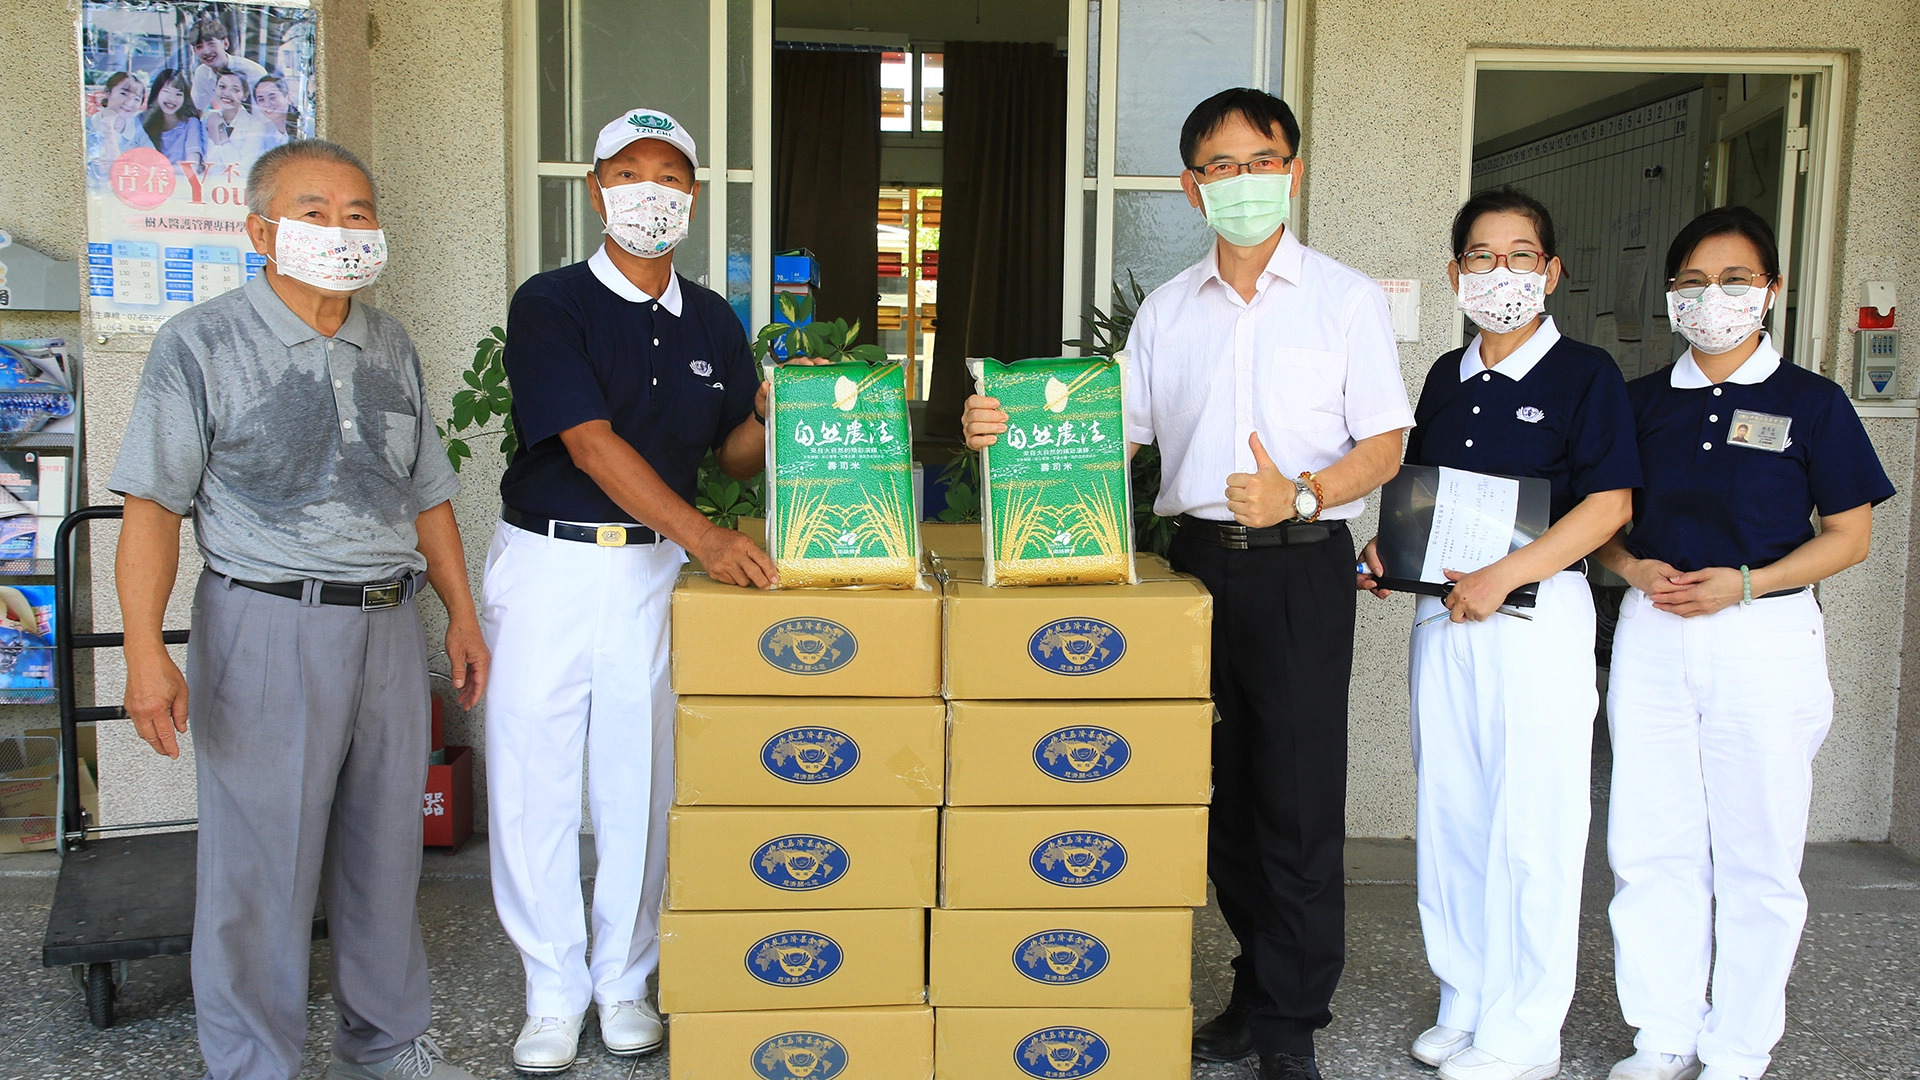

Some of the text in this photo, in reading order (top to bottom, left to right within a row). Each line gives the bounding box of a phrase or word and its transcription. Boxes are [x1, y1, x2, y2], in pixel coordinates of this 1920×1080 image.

[1556, 138, 1564, 150] 13
[1564, 135, 1572, 147] 12
[1573, 133, 1579, 144] 11
[1581, 129, 1588, 141] 10
[1590, 126, 1596, 138] 9
[1599, 124, 1605, 137] 8
[1608, 121, 1614, 134] 7
[1617, 118, 1623, 131] 6
[1627, 115, 1633, 129] 5
[1636, 112, 1642, 125] 4
[1647, 108, 1653, 122] 3
[1656, 105, 1663, 119] 2
[1668, 103, 1673, 116] 1
[117, 164, 170, 193] 青春
[179, 160, 248, 206] You
[221, 163, 241, 183] 不
[827, 461, 860, 470] 壽司米
[1040, 462, 1072, 471] 壽司米
[999, 558, 1060, 571] NATURAL
[423, 792, 445, 816] 器
